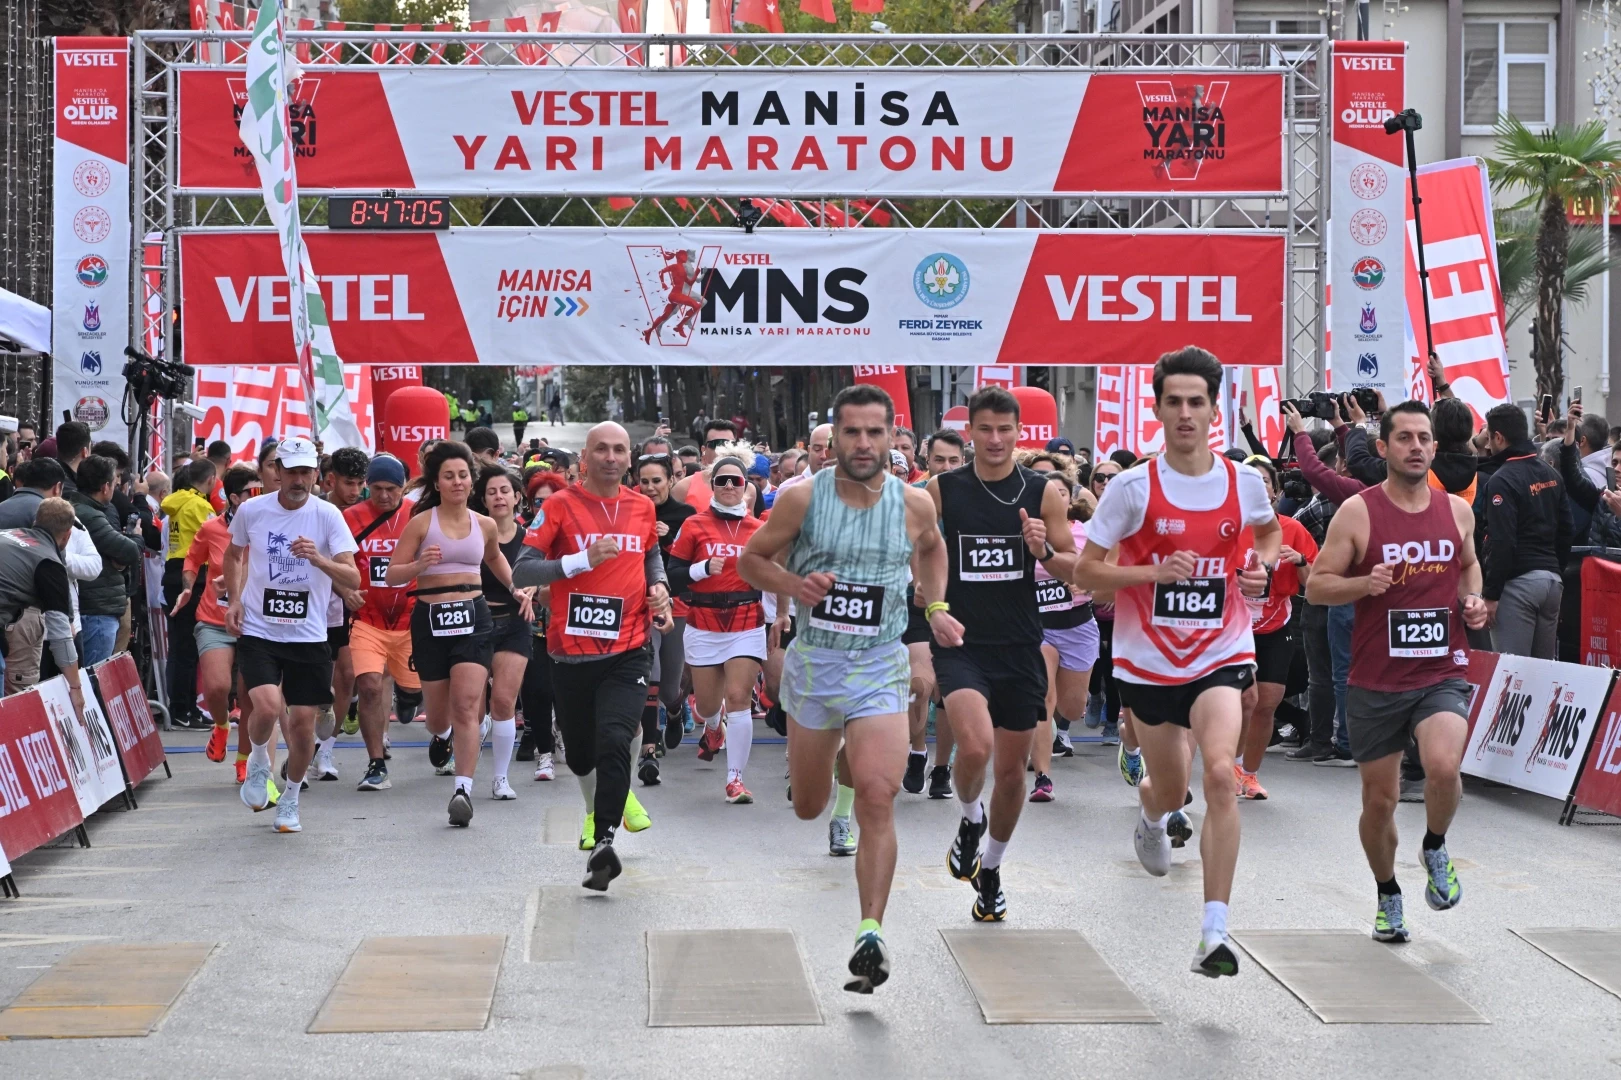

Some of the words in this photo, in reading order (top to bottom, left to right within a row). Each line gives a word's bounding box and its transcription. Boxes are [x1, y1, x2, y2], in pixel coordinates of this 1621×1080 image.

[62, 53, 118, 66] VESTEL
[1341, 57, 1396, 70] VESTEL
[72, 97, 110, 105] VESTEL'LE
[511, 90, 669, 126] VESTEL
[701, 82, 960, 126] MANİSA
[1145, 94, 1174, 102] VESTEL
[63, 105, 118, 120] OLUR
[1143, 103, 1225, 121] MANİSA
[1144, 122, 1225, 147] YARI
[452, 135, 603, 171] YARI
[644, 135, 1013, 171] MARATONU
[1143, 149, 1225, 160] MARATONU
[351, 200, 442, 225] 8:47:05
[723, 253, 773, 265] VESTEL
[214, 274, 425, 322] VETEL
[700, 267, 870, 324] MNS
[1044, 274, 1252, 322] VESTEL
[700, 325, 753, 336] MANİSA
[759, 327, 789, 336] YARI
[796, 327, 871, 336] MARATONU
[935, 319, 983, 330] ZEYREK
[372, 365, 419, 382] VESTEL
[853, 364, 898, 377] VESTEL
[390, 426, 448, 442] VESTEL
[1018, 424, 1054, 441] STEL
[361, 538, 399, 553] VEST
[705, 543, 746, 558] VEST
[1382, 539, 1455, 565] BOLD
[969, 548, 1014, 567] 1231
[1390, 554, 1448, 585] Union
[834, 583, 849, 592] 10K
[852, 585, 868, 593] MNS
[1036, 586, 1066, 603] 1120
[268, 599, 305, 614] 1336
[596, 596, 609, 604] MNS
[823, 595, 874, 620] 1381
[1164, 591, 1217, 612] 1184
[436, 609, 470, 626] 1281
[573, 606, 616, 626] 1029
[1177, 619, 1201, 627] VESTEL
[833, 624, 856, 632] VESTEL
[1397, 622, 1445, 642] 1230
[1490, 691, 1532, 747] MNS
[1540, 703, 1587, 760] MNS
[15, 729, 68, 800] VESTEL
